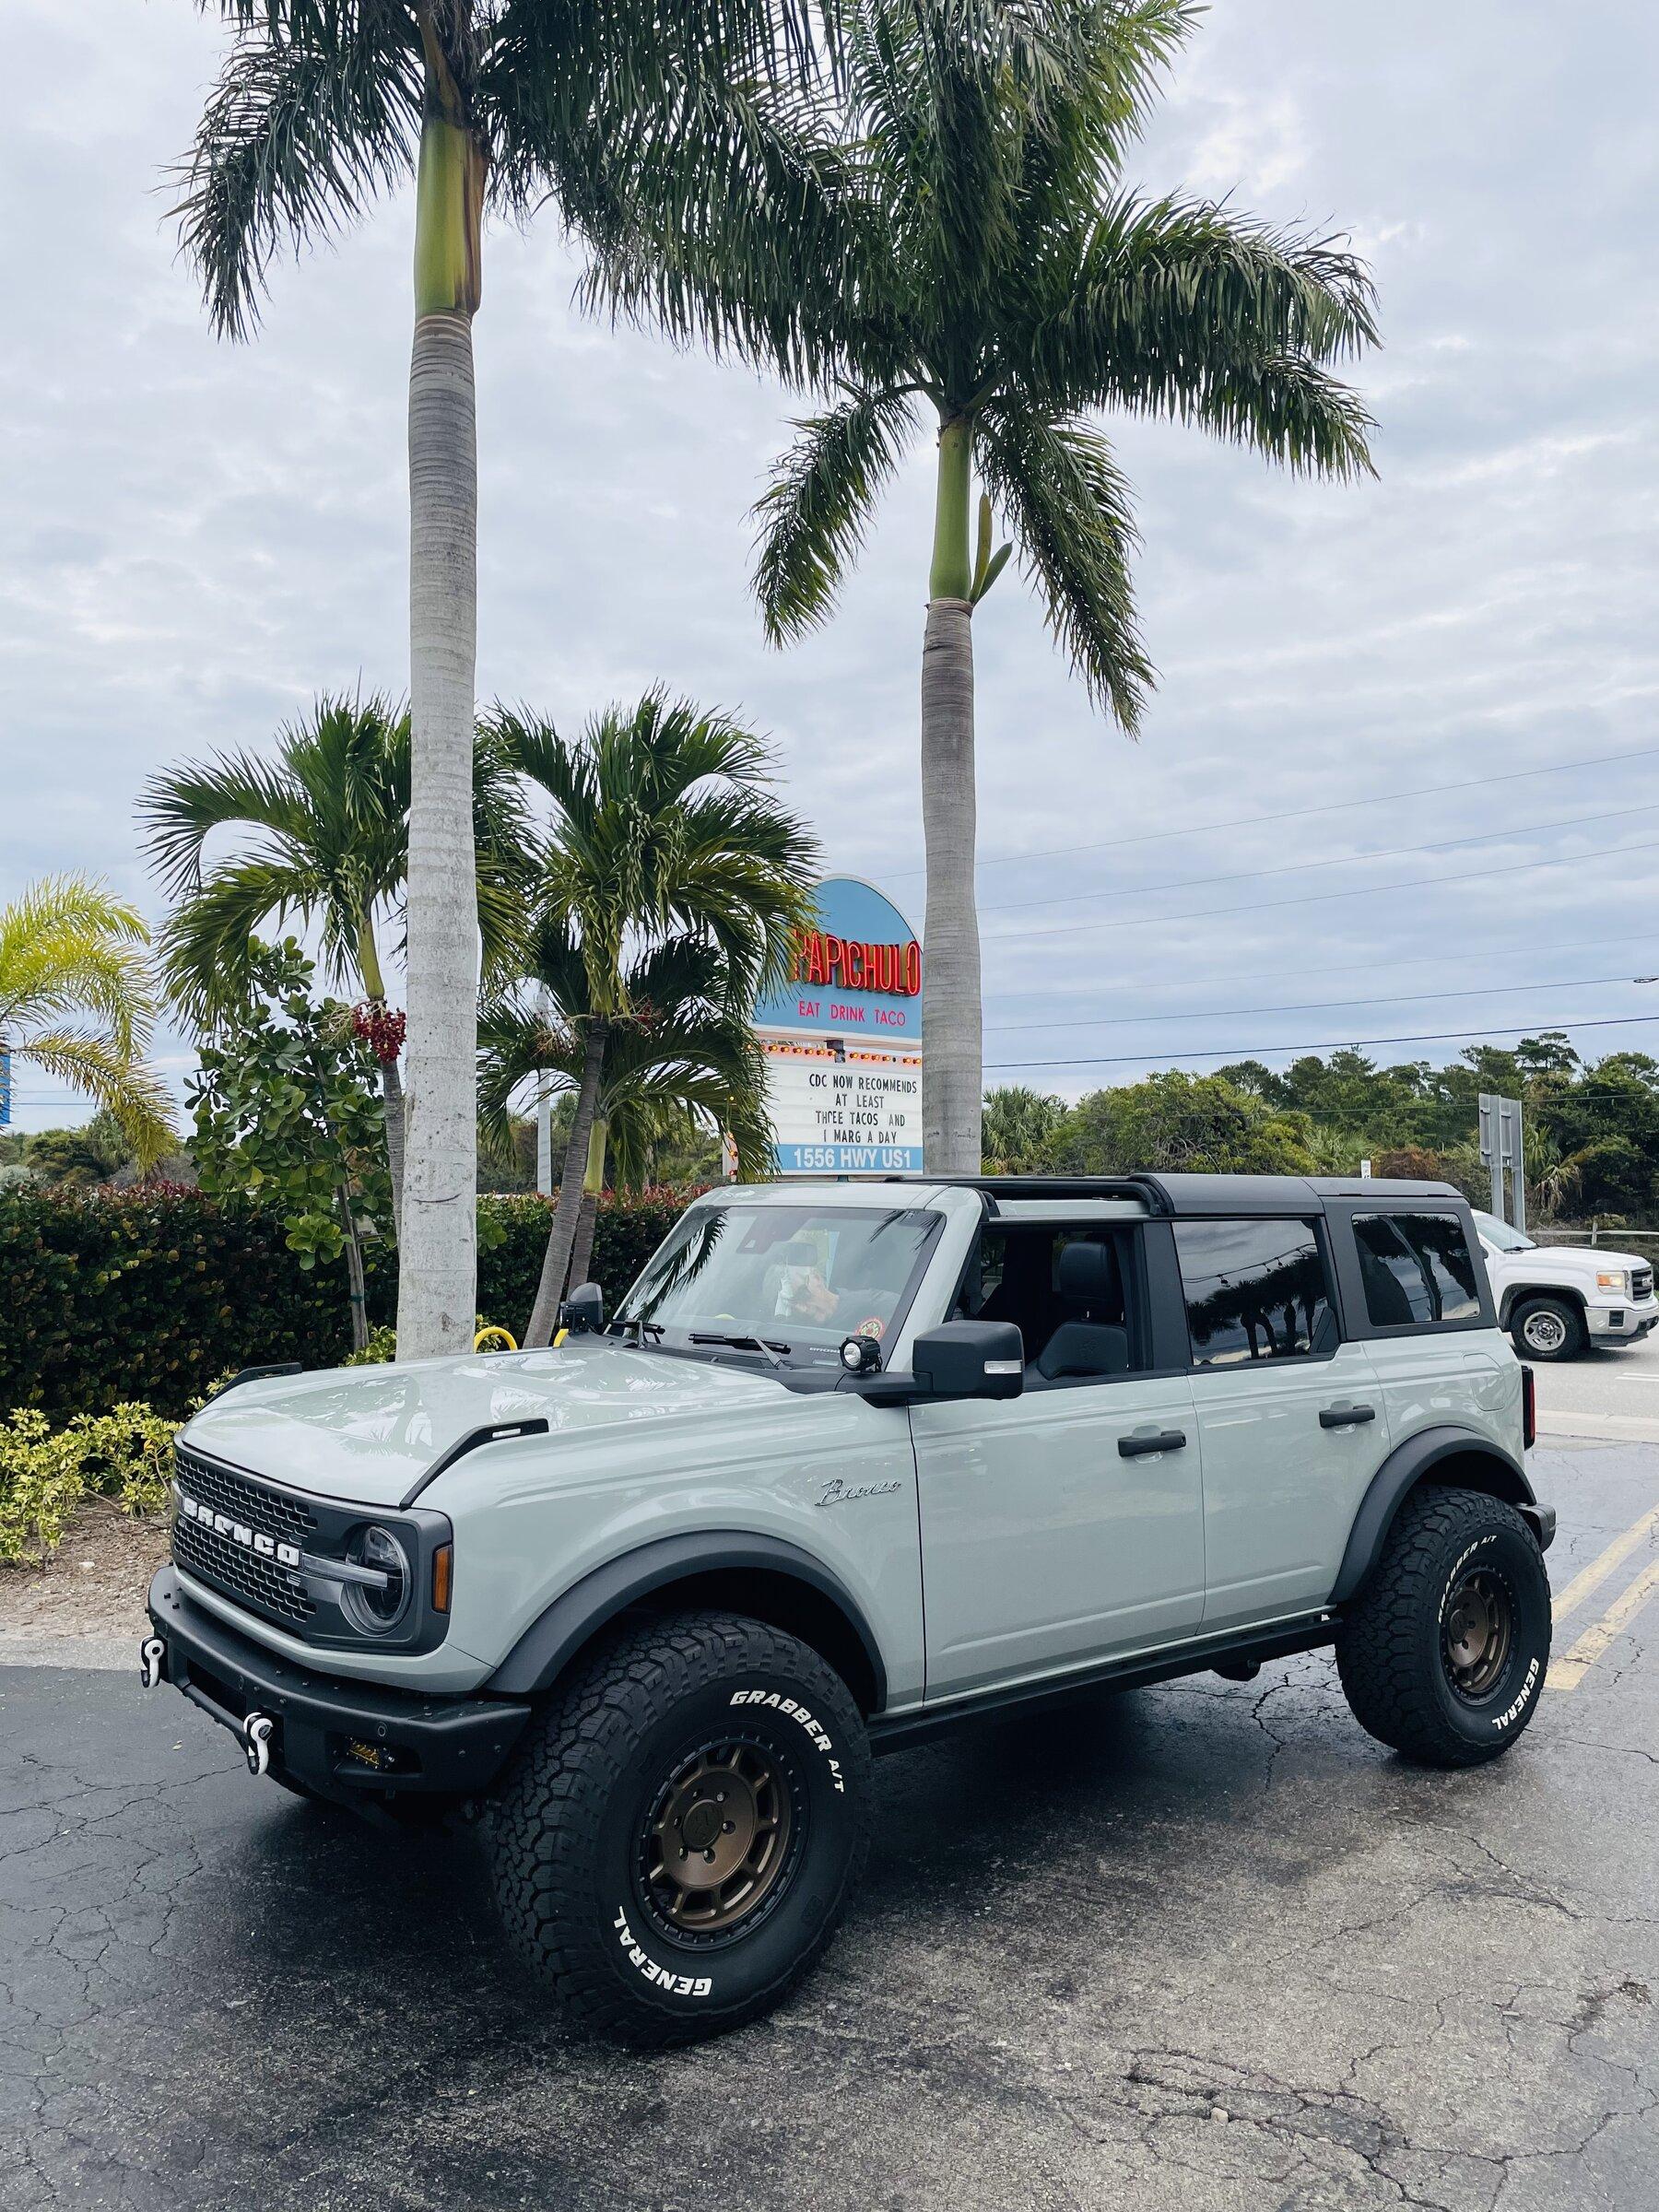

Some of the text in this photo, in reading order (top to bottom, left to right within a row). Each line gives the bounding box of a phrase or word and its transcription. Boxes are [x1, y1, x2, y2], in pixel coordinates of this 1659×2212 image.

[799, 1000, 906, 1026] EAT DRINK TACO
[809, 1073, 917, 1094] CDC NOW RECOMMENDS
[835, 1093, 884, 1109] AT LEAST
[850, 1112, 878, 1125] TACOS
[888, 1113, 905, 1126] AND
[834, 1129, 861, 1143] MARG
[867, 1131, 873, 1143] A
[878, 1131, 897, 1144] DAY
[794, 1147, 911, 1169] 1556 HWY US1
[814, 1478, 901, 1506] Bronco
[183, 1496, 300, 1567] BRONCO
[1481, 1535, 1497, 1546] A/T
[1491, 1657, 1539, 1730] GENERAL
[729, 1689, 844, 1793] GRABBER A/T
[613, 1905, 712, 1997] GENERAL
